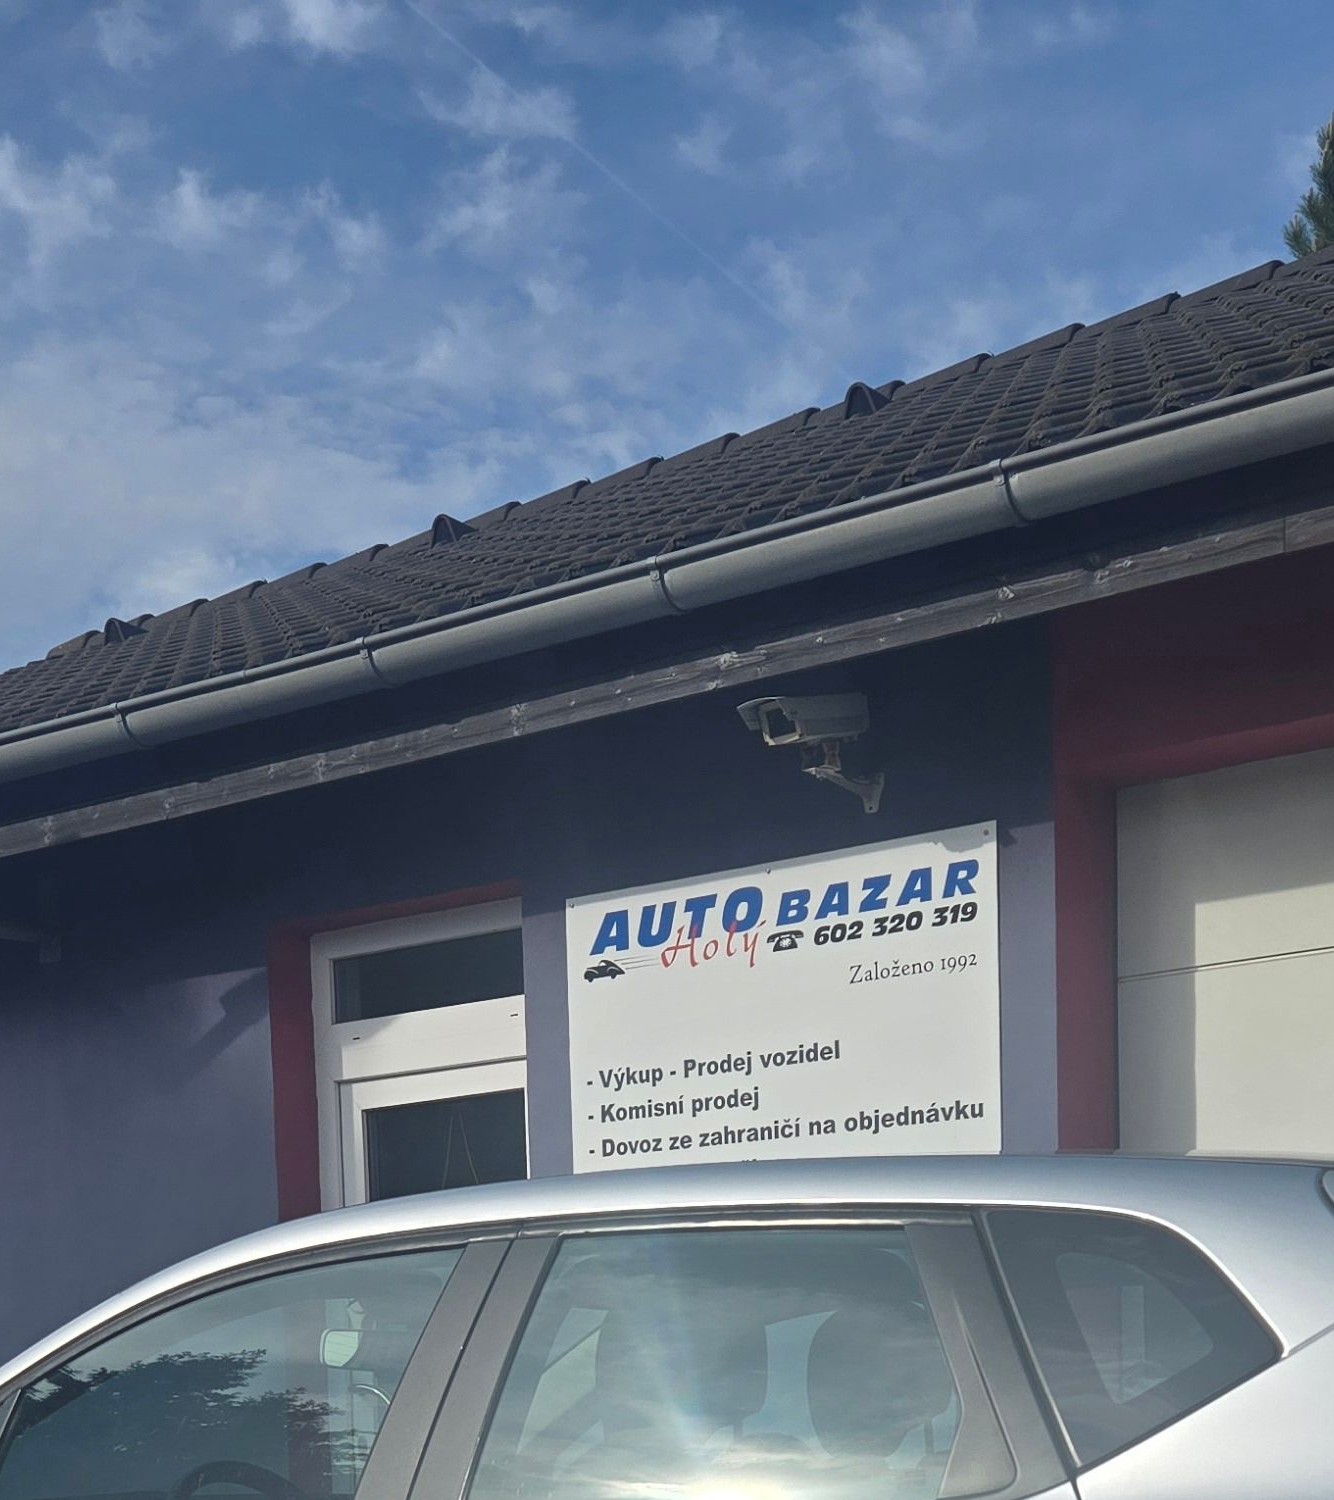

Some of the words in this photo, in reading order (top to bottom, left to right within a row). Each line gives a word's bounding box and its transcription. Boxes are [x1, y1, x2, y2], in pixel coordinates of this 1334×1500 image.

[660, 918, 767, 968] Holý
[814, 920, 864, 946] 602
[871, 910, 923, 937] 320
[931, 901, 978, 928] 319
[849, 959, 934, 985] Založeno
[941, 953, 977, 975] 1992
[599, 1066, 663, 1092] Výkup
[684, 1051, 752, 1078] Prodej
[760, 1040, 840, 1069] vozidel
[601, 1095, 684, 1123] Komisní
[692, 1086, 759, 1117] prodej
[602, 1138, 662, 1157] Dovoz
[669, 1135, 692, 1150] ze
[699, 1118, 800, 1147] zahraničí
[808, 1119, 836, 1136] na
[844, 1100, 984, 1134] objednávku
